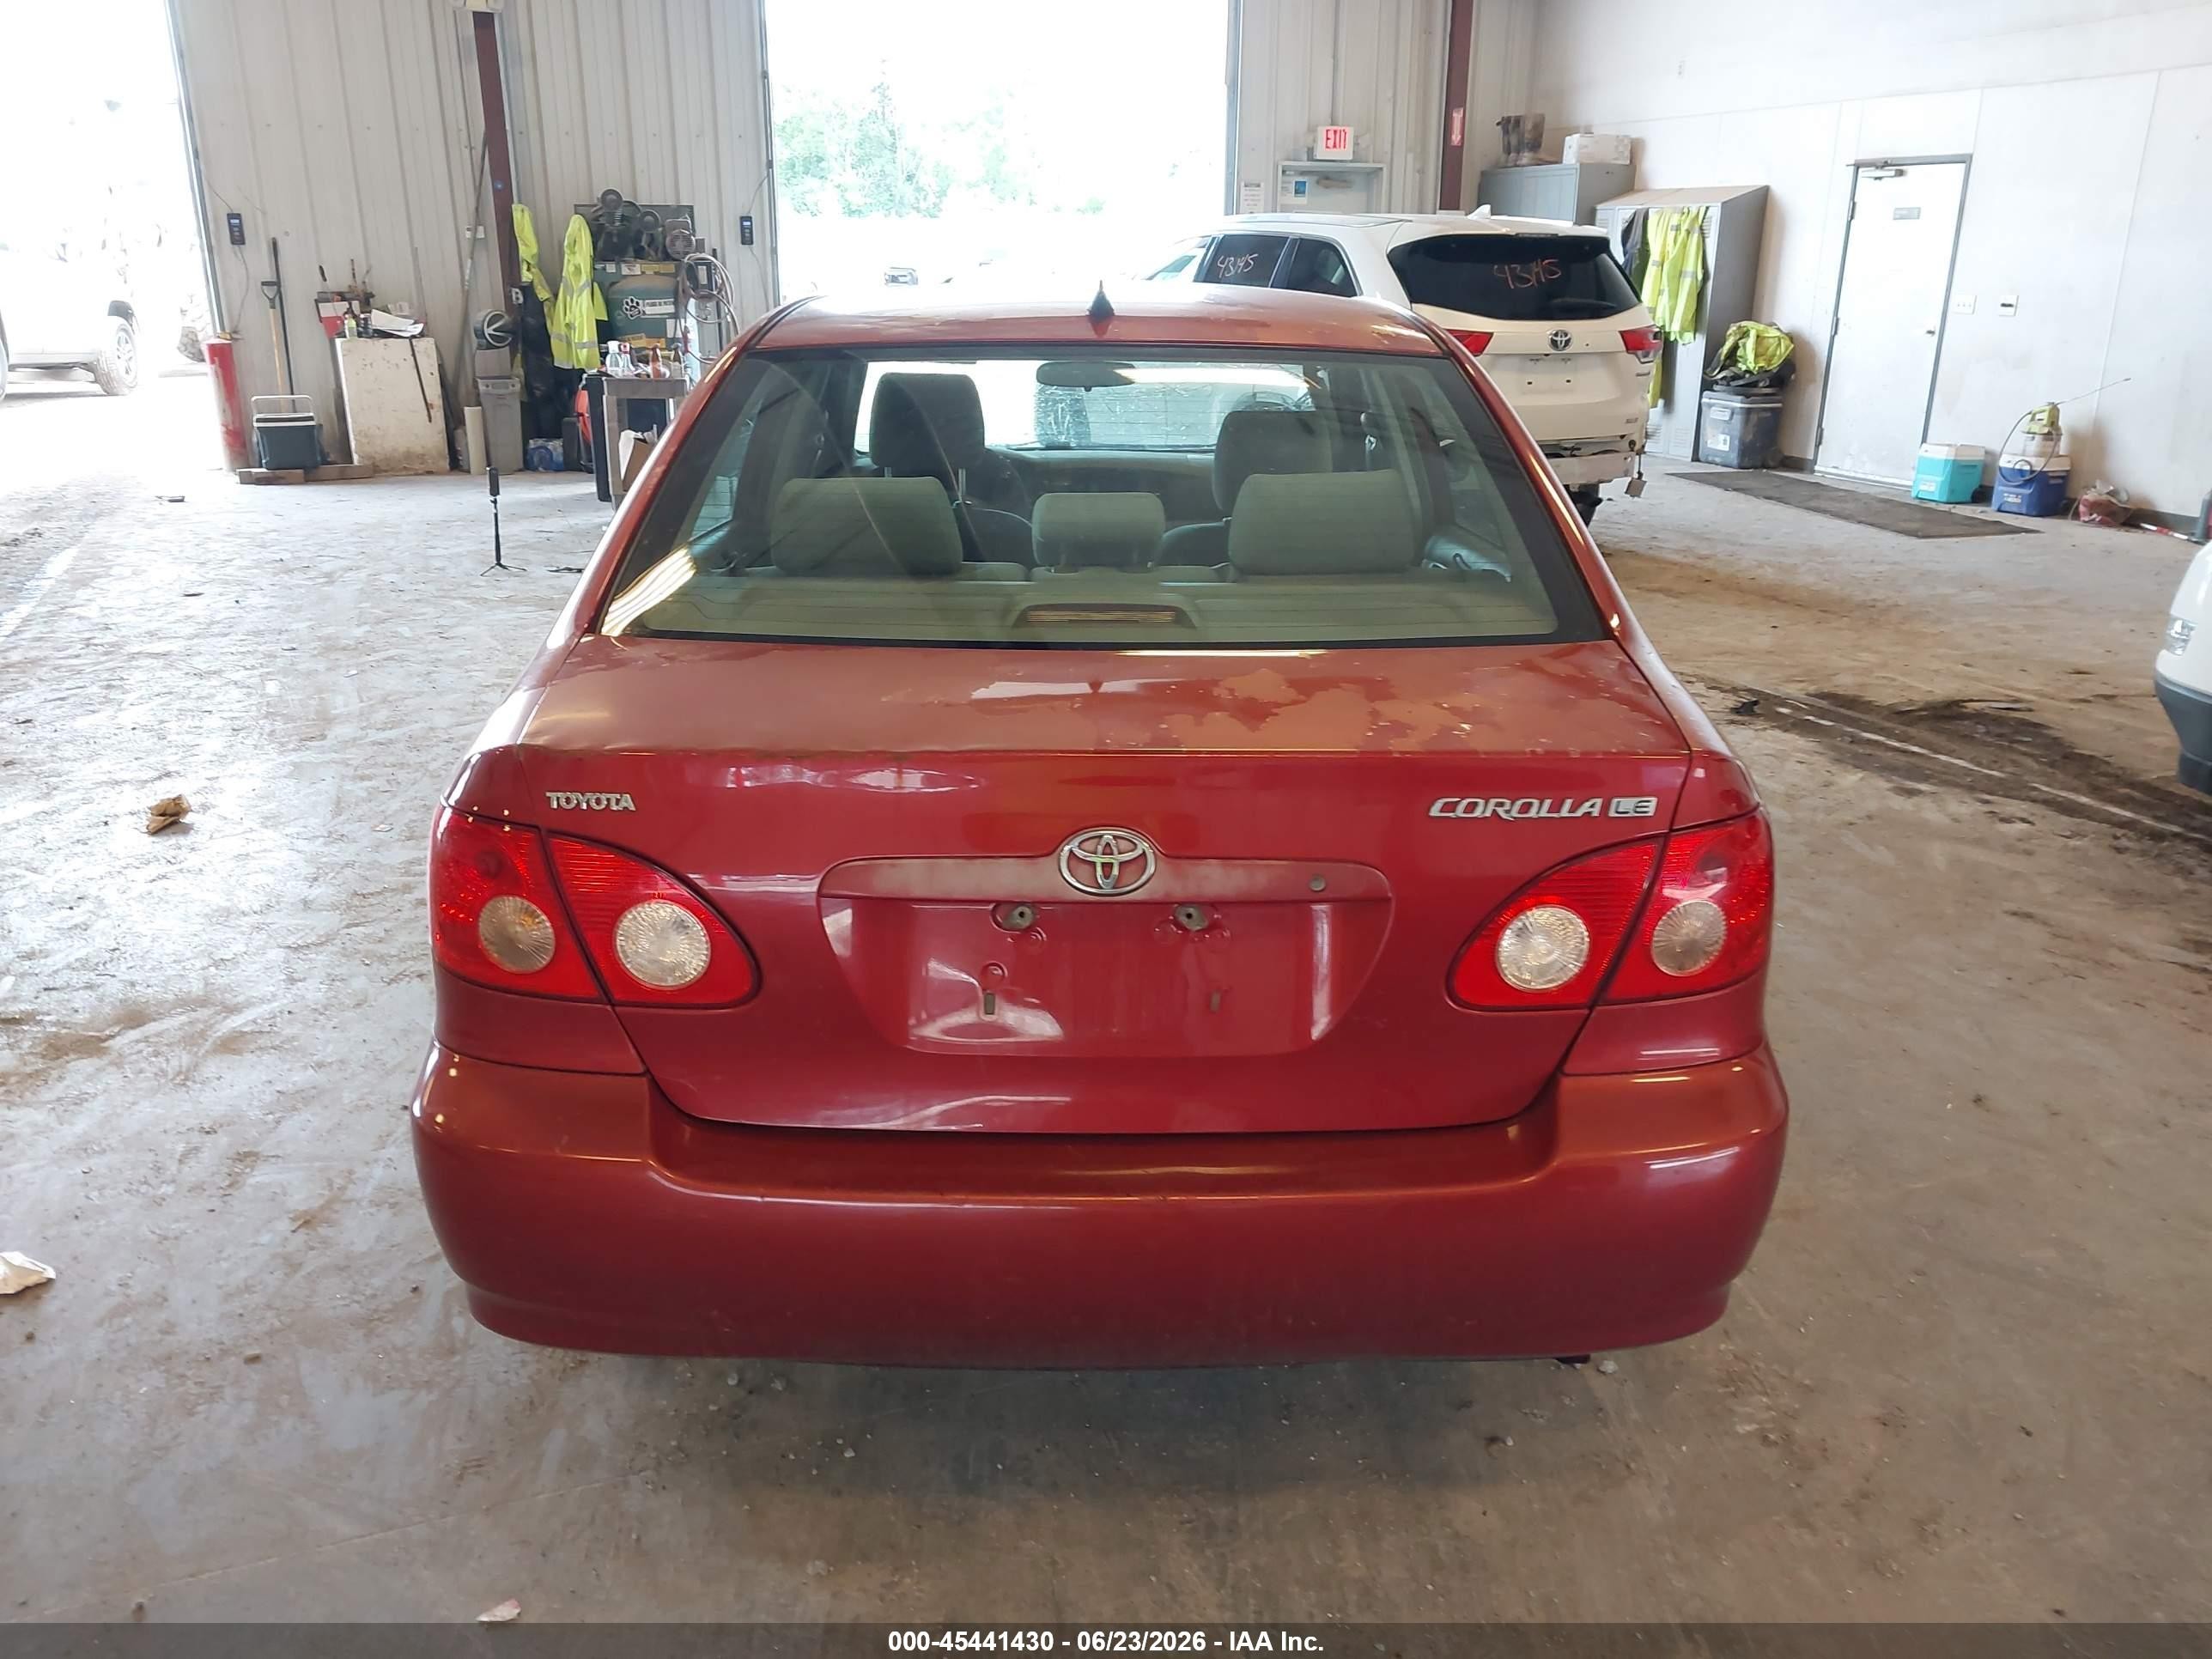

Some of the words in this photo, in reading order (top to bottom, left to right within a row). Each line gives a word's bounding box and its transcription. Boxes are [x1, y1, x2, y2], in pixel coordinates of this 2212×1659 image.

[1325, 129, 1347, 149] EXIT
[545, 791, 636, 811] TOYOTA
[1428, 797, 1603, 821] COROLLA
[1607, 796, 1658, 817] LE
